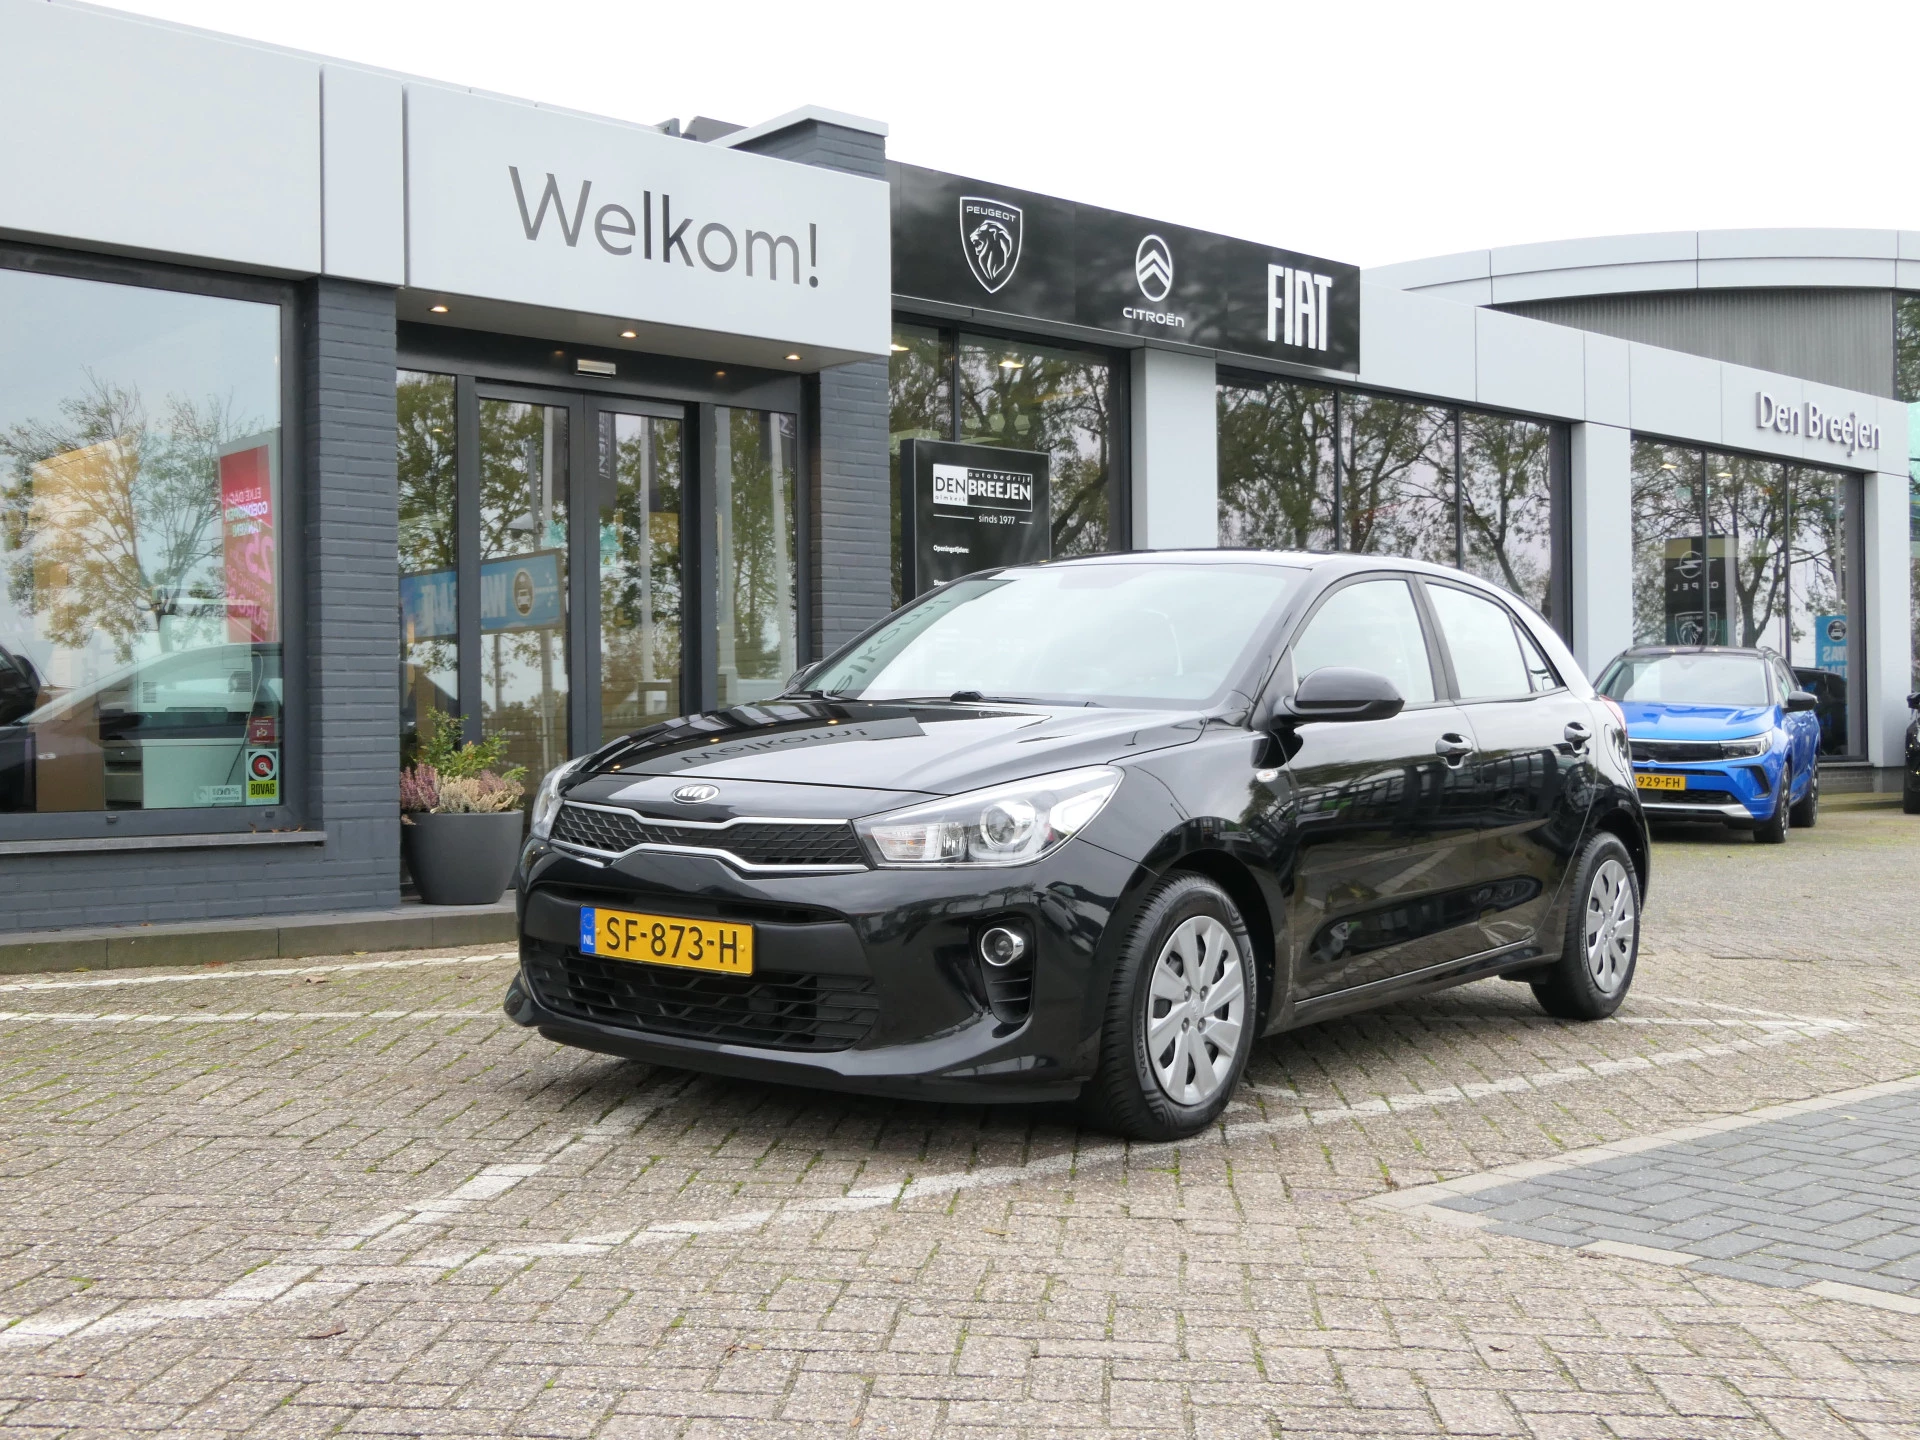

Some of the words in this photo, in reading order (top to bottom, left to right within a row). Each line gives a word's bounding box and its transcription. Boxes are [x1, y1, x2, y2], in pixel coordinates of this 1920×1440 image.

[966, 206, 1016, 222] PEUGEOT
[508, 165, 819, 288] Welkom!
[1122, 307, 1184, 327] CITROËN
[1267, 263, 1334, 351] FIAT
[1756, 391, 1800, 435] Den
[1804, 402, 1880, 457] Breejen
[968, 472, 1031, 483] autobedrijf
[935, 476, 967, 495] DEN
[968, 479, 1031, 501] BREEJEN
[978, 514, 998, 524] sinds
[1000, 515, 1016, 525] 1977
[250, 783, 275, 796] BOVAG
[677, 785, 708, 799] KIA
[583, 934, 594, 946] NL
[606, 916, 738, 964] SF-873-H
